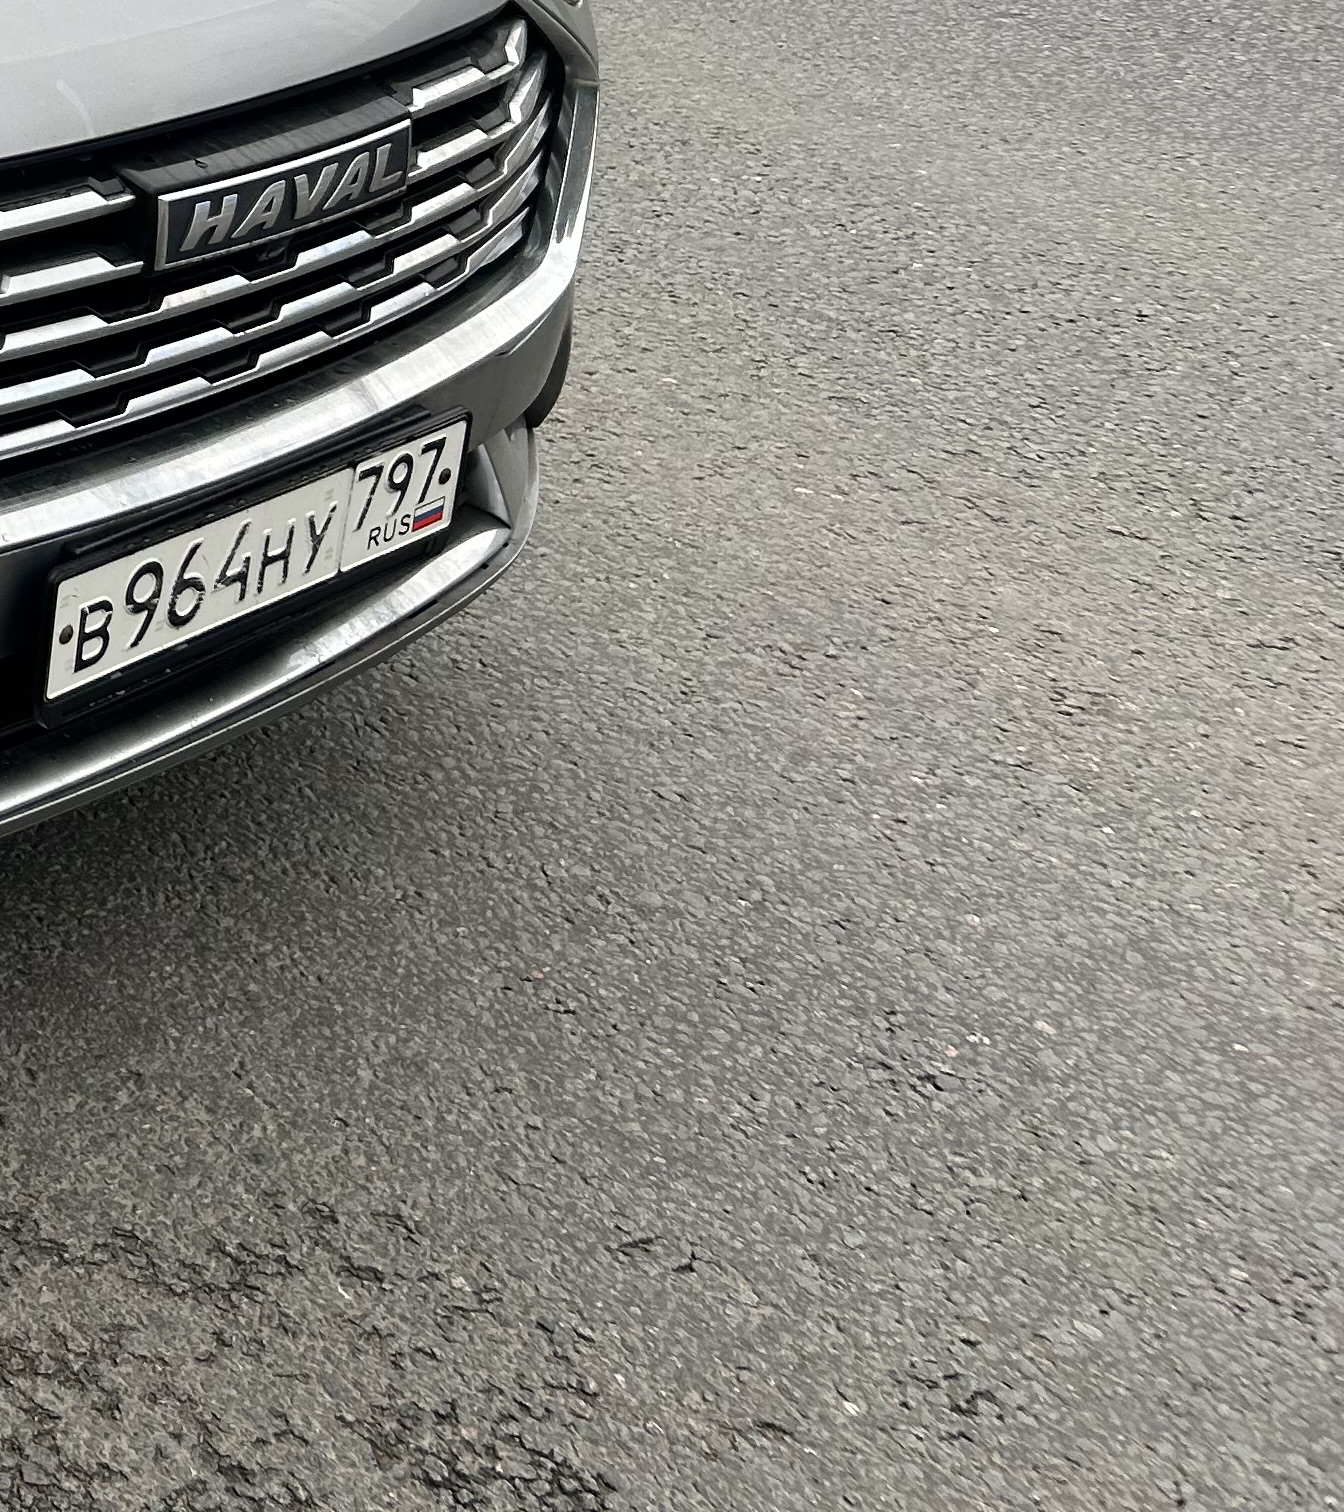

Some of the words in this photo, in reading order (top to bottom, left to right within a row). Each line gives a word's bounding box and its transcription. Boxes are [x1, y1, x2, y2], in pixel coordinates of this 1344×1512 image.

[179, 143, 403, 252] HAVAL
[73, 500, 338, 673] В964НУ
[353, 435, 448, 533] 797
[367, 516, 412, 551] RUS
